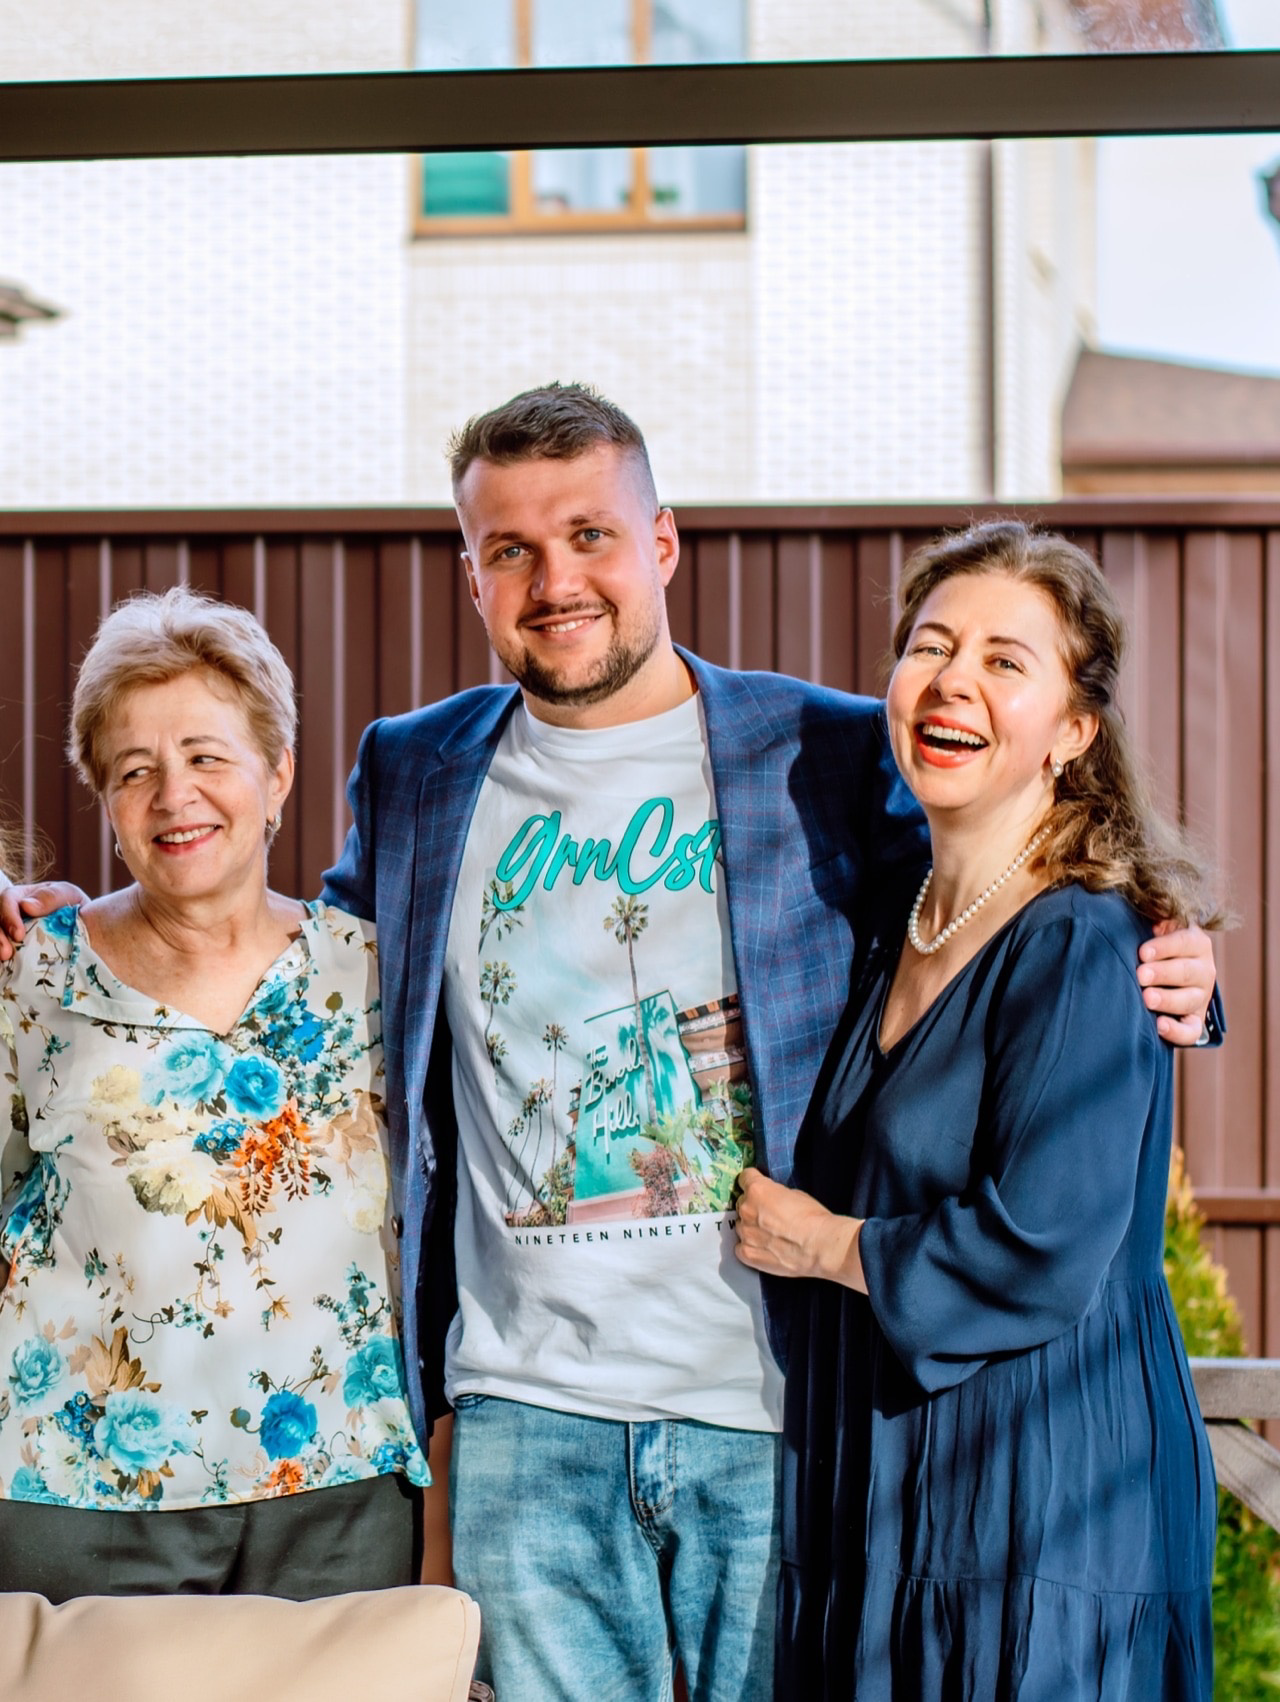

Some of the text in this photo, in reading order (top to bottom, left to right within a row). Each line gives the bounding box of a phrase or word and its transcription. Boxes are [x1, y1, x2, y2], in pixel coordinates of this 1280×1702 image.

[515, 1219, 737, 1245] NINETEEN NINETY TW
